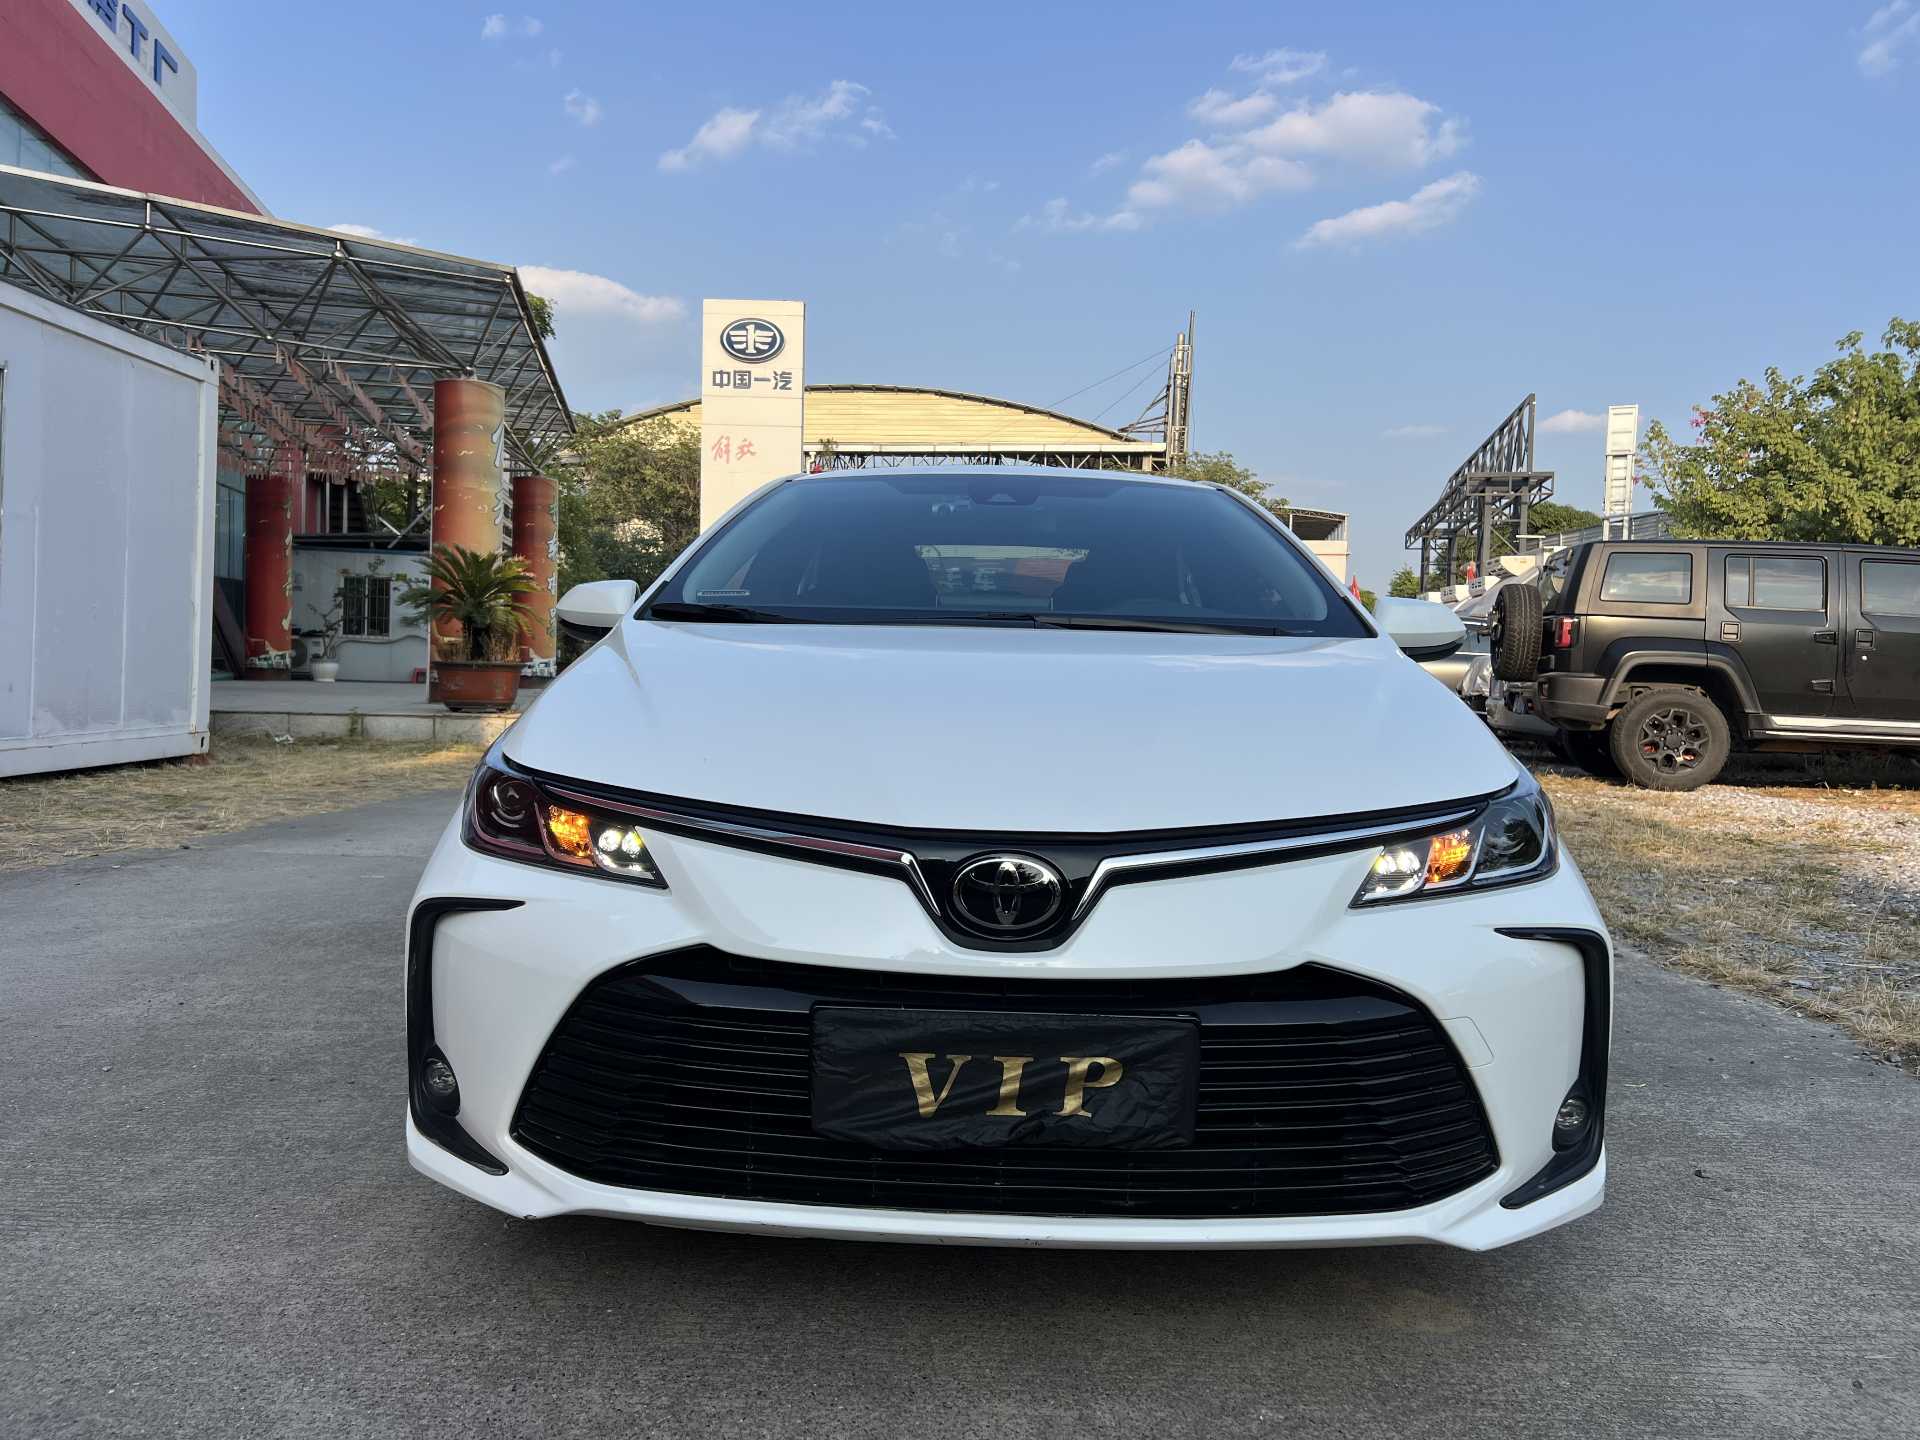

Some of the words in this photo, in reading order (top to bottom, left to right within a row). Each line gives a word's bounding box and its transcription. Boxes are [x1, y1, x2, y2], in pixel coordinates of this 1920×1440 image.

[712, 369, 793, 391] 中国一汽
[898, 1052, 1124, 1119] VIP
